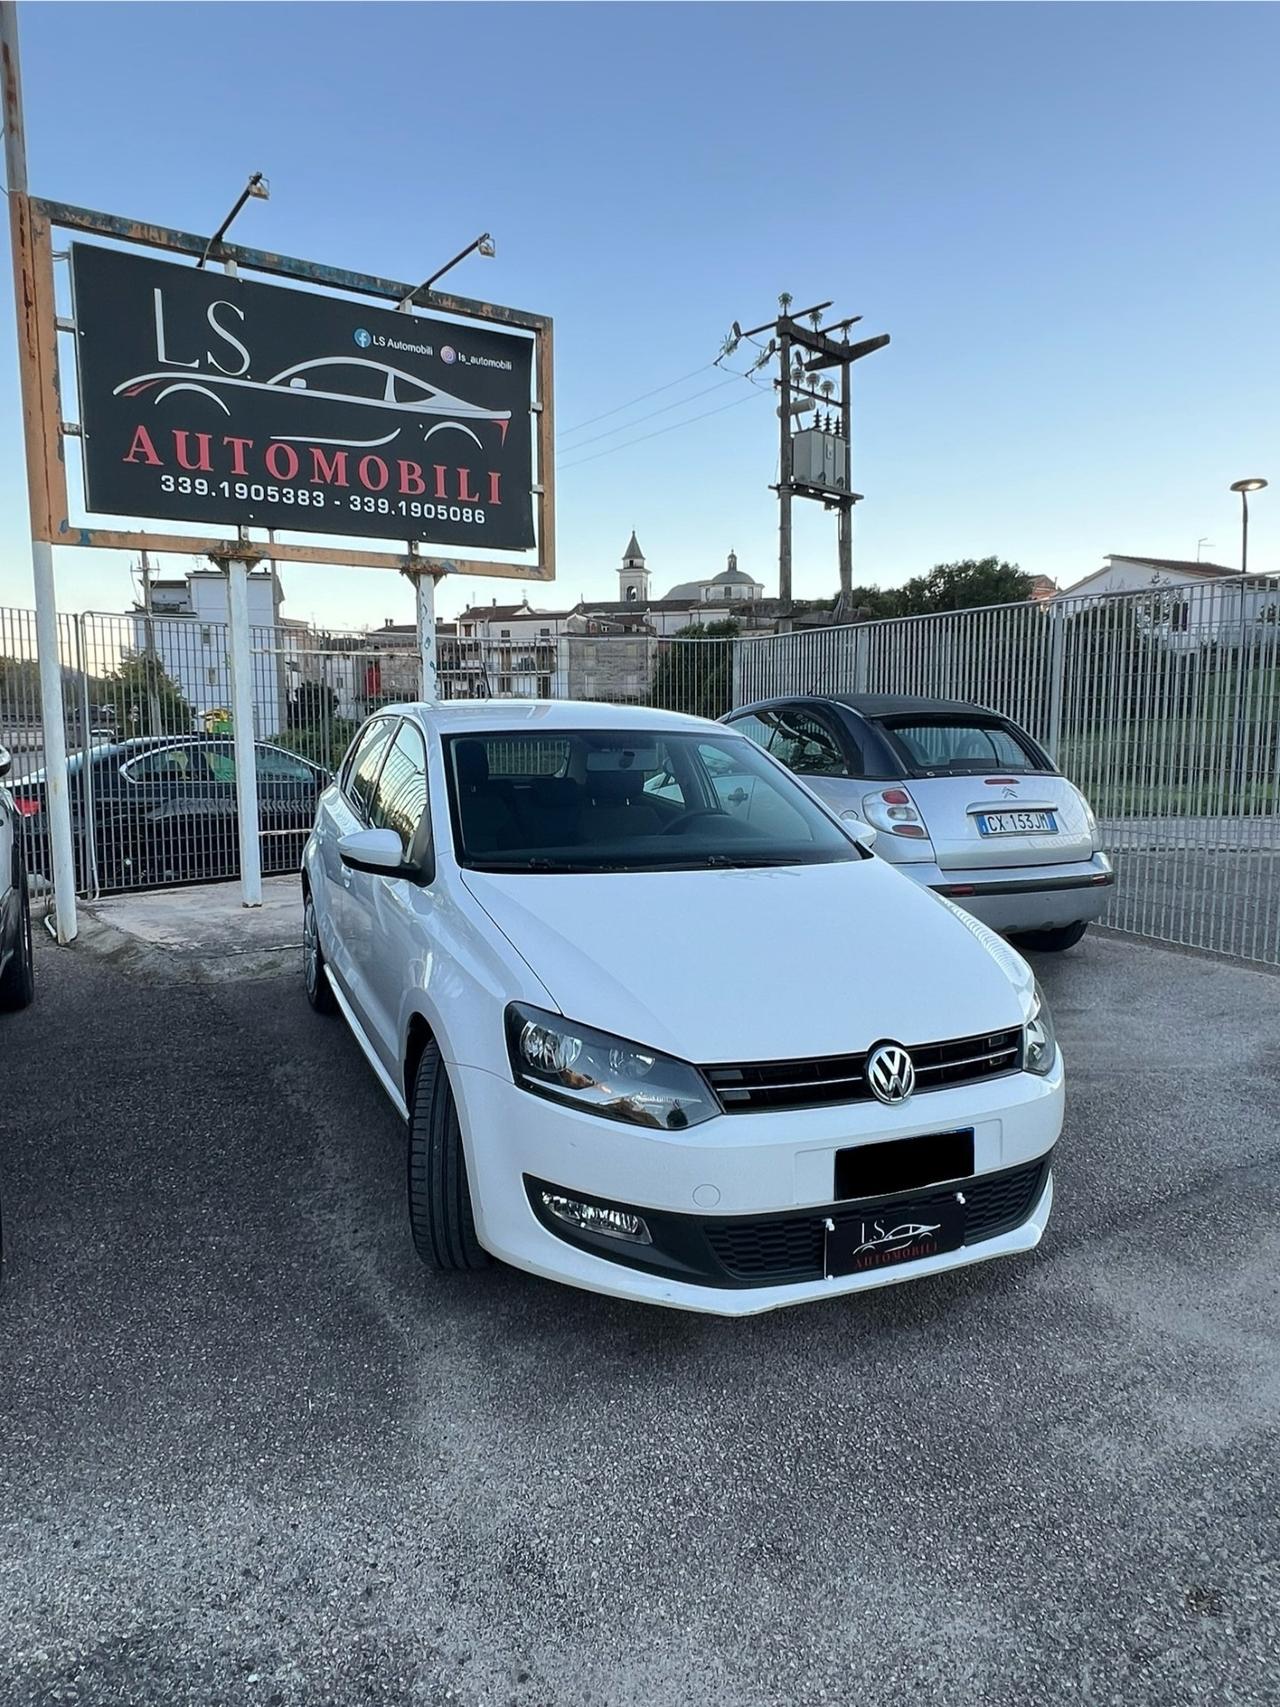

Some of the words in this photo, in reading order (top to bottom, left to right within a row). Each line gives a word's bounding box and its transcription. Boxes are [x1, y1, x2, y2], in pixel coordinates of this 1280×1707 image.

[153, 288, 251, 376] LS
[373, 335, 386, 347] LS
[387, 338, 434, 356] Automobili
[123, 424, 502, 505] AUTOMOBILI
[160, 474, 325, 507] 339.1905383
[349, 494, 486, 525] 339.1905086
[987, 815, 1007, 832] CX
